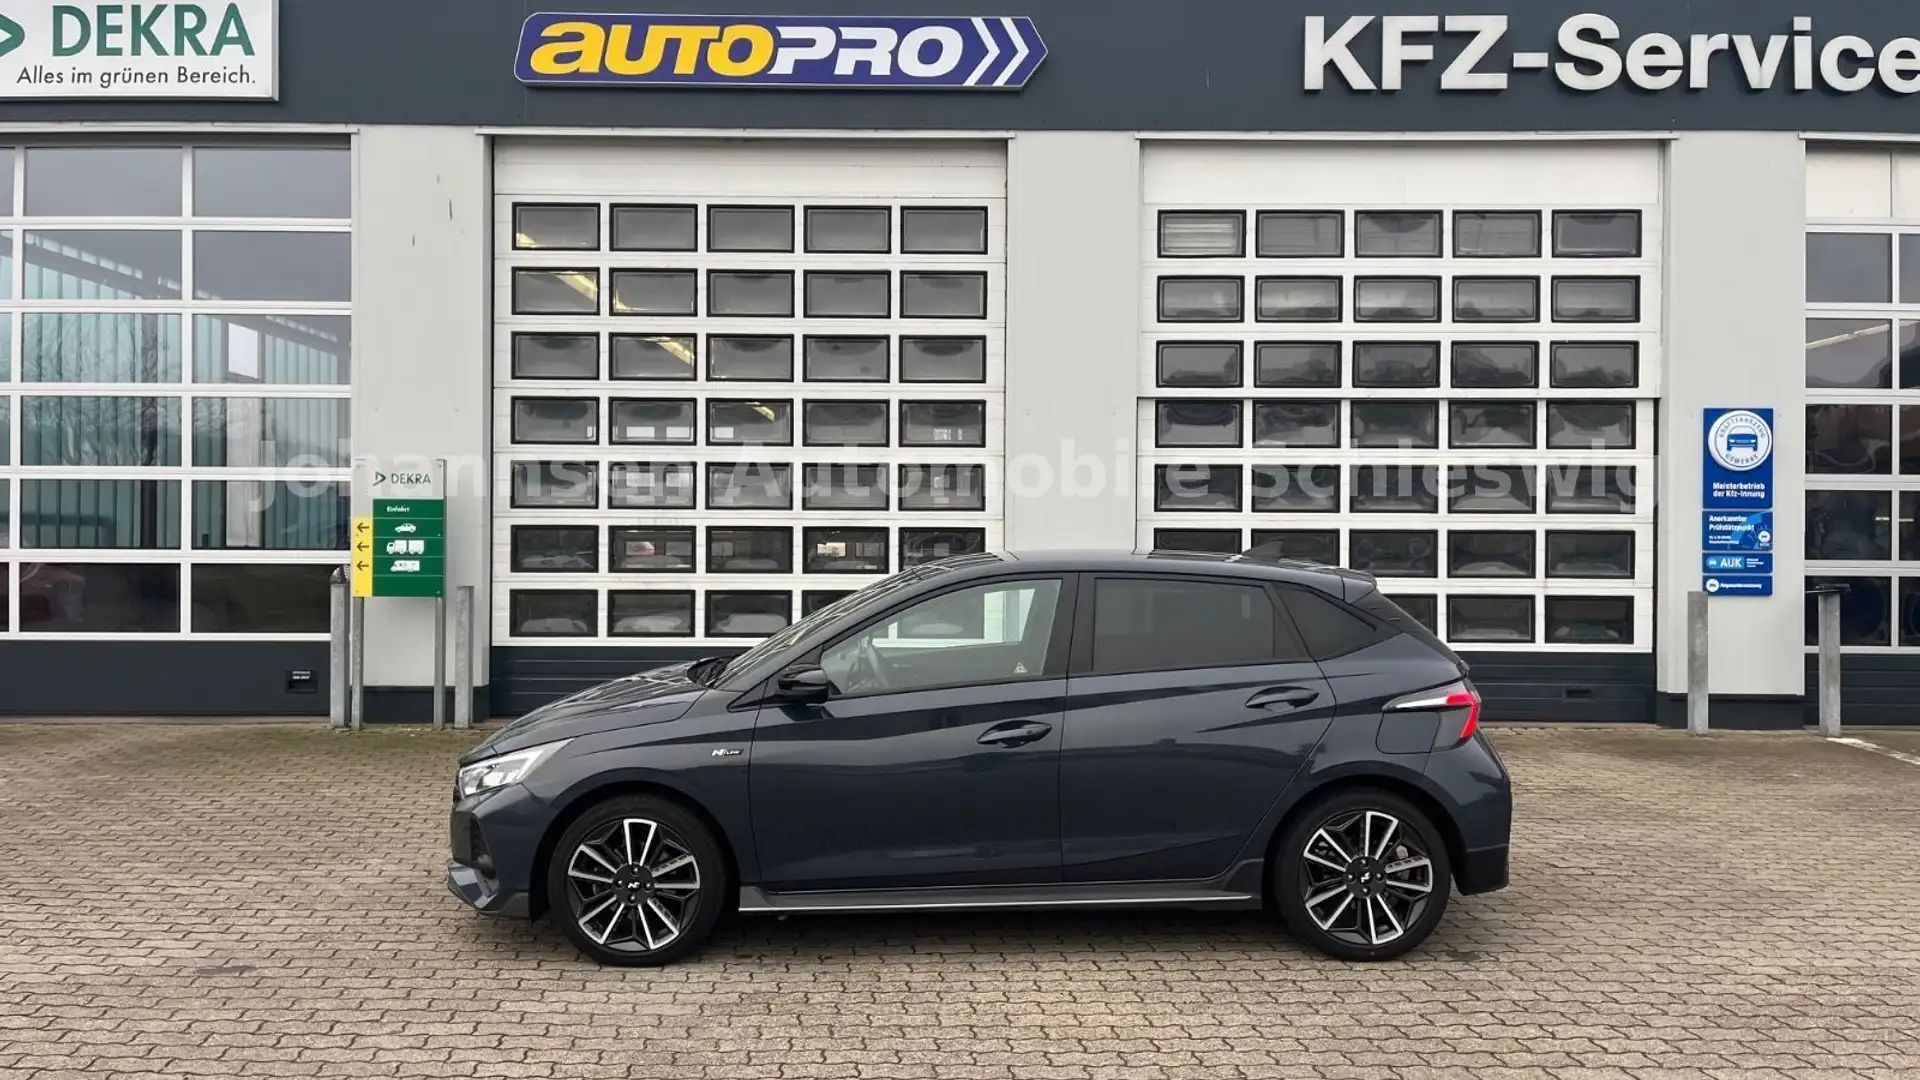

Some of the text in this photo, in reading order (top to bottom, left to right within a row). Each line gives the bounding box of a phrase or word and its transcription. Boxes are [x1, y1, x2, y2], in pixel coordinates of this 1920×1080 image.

[52, 3, 256, 56] DEKRA
[1303, 13, 1920, 93] KFZ-Service
[16, 65, 256, 88] Alles im grünen Bereich.
[391, 473, 431, 484] DEKRA
[1713, 482, 1765, 490] Meisterbetrieb
[1720, 558, 1742, 568] AUK
